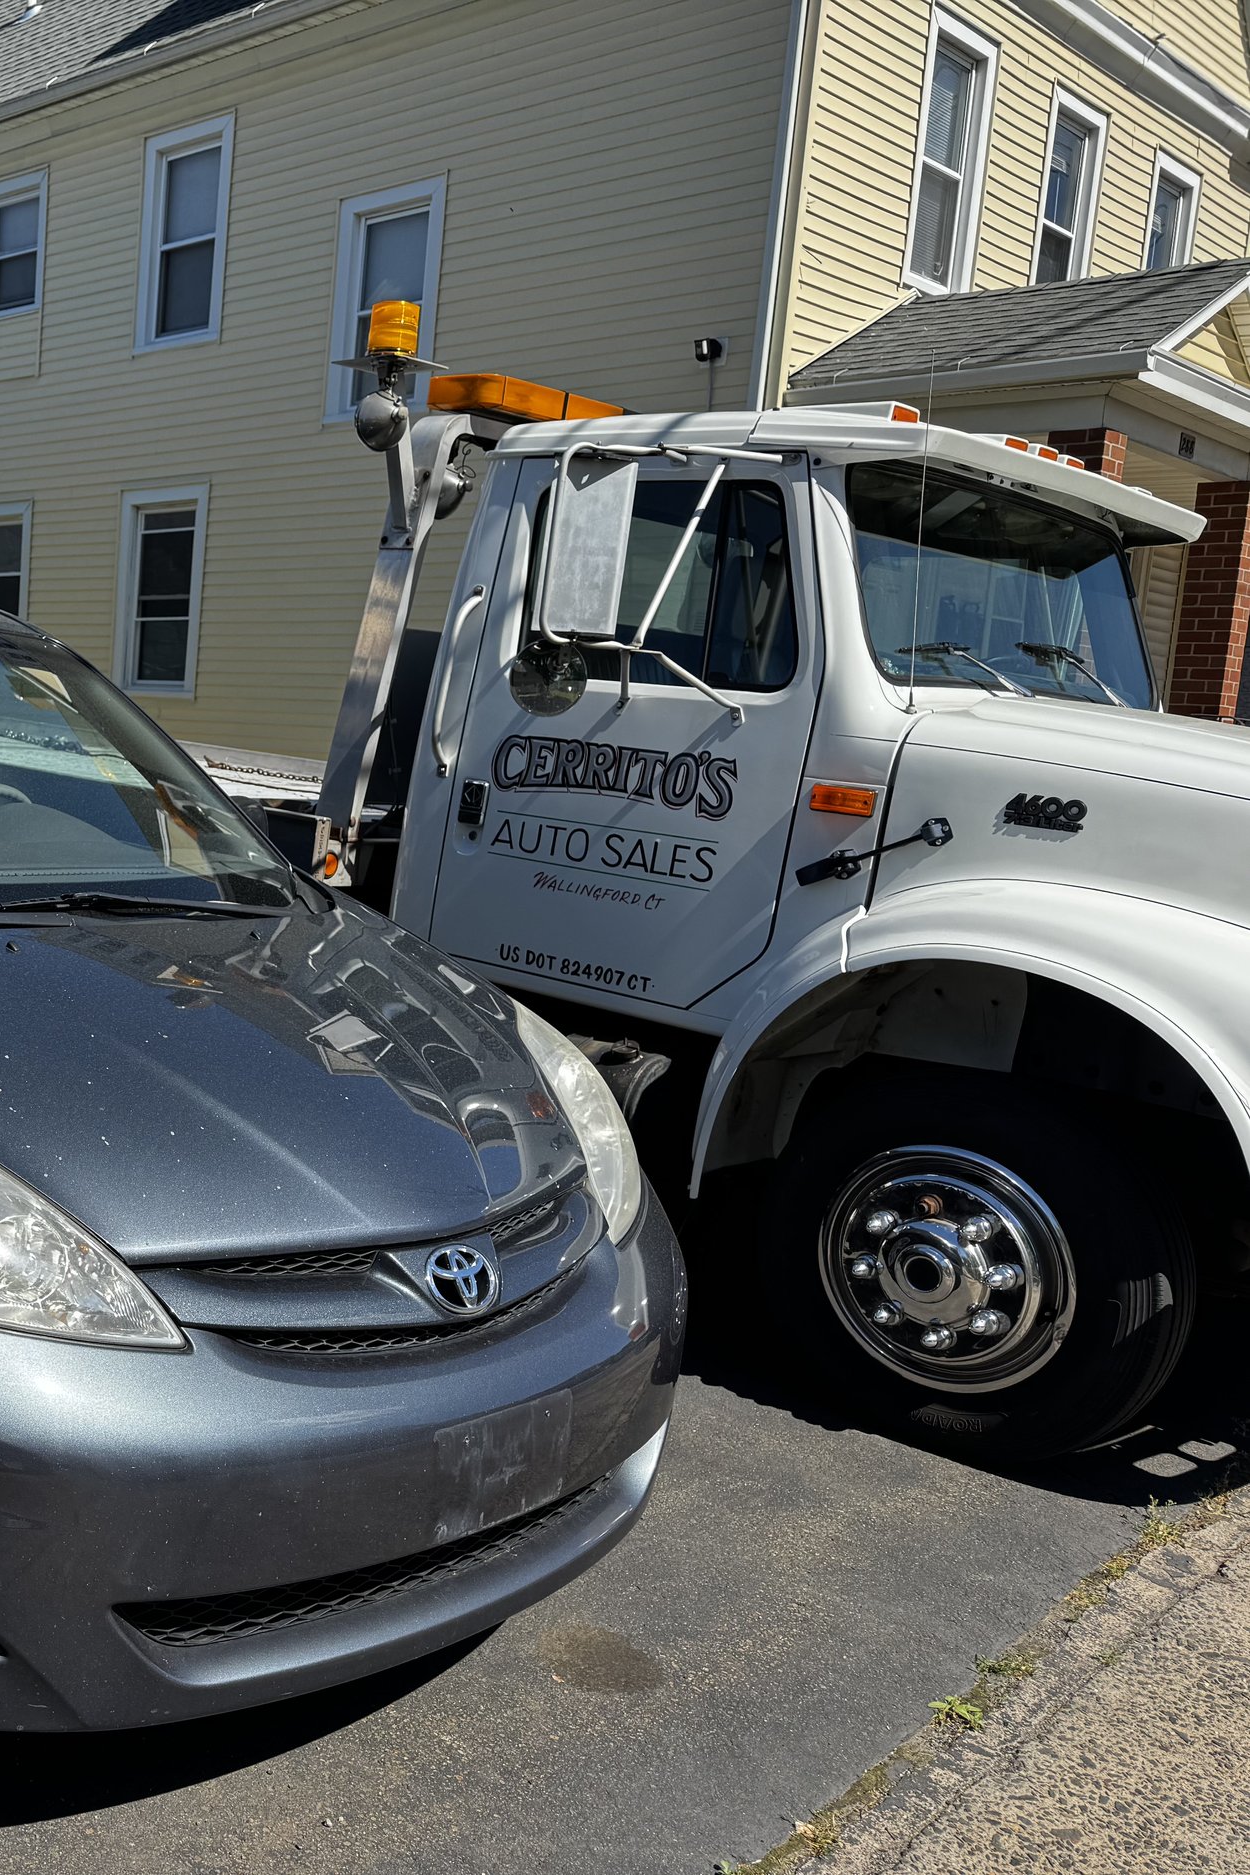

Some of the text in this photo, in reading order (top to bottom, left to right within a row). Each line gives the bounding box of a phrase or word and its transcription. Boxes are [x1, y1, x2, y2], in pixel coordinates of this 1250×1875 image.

[491, 734, 738, 821] CERRITO'S
[1005, 793, 1088, 822] 4600
[491, 819, 718, 883] AUTO SALES
[645, 893, 666, 910] CT
[499, 943, 652, 992] US DOT 824907 CT
